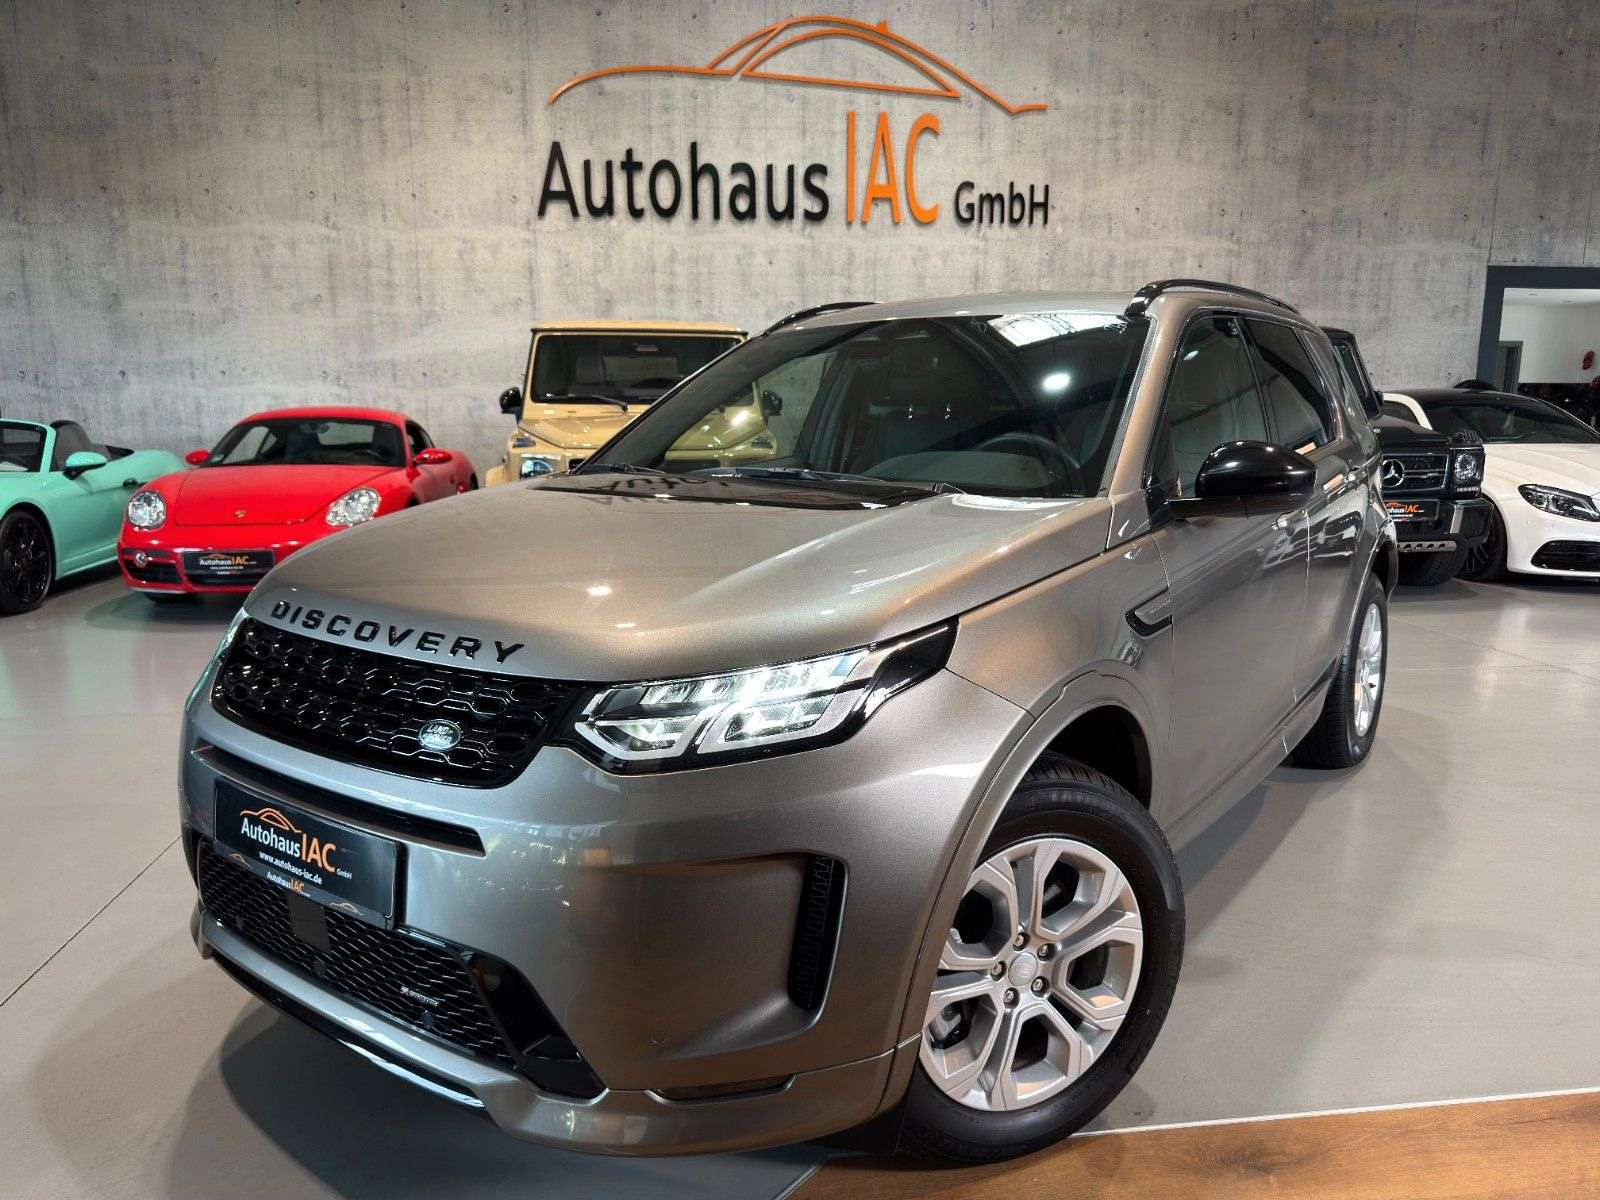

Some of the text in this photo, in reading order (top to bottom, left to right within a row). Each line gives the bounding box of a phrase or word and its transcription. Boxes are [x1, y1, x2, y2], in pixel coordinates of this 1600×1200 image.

[537, 111, 1050, 225] Autohaus IAC GmbH
[271, 600, 525, 664] DISCOVERY
[241, 817, 301, 858] Autohaus
[302, 833, 337, 872] IAC
[259, 851, 323, 885] www.autohaus-iac.de
